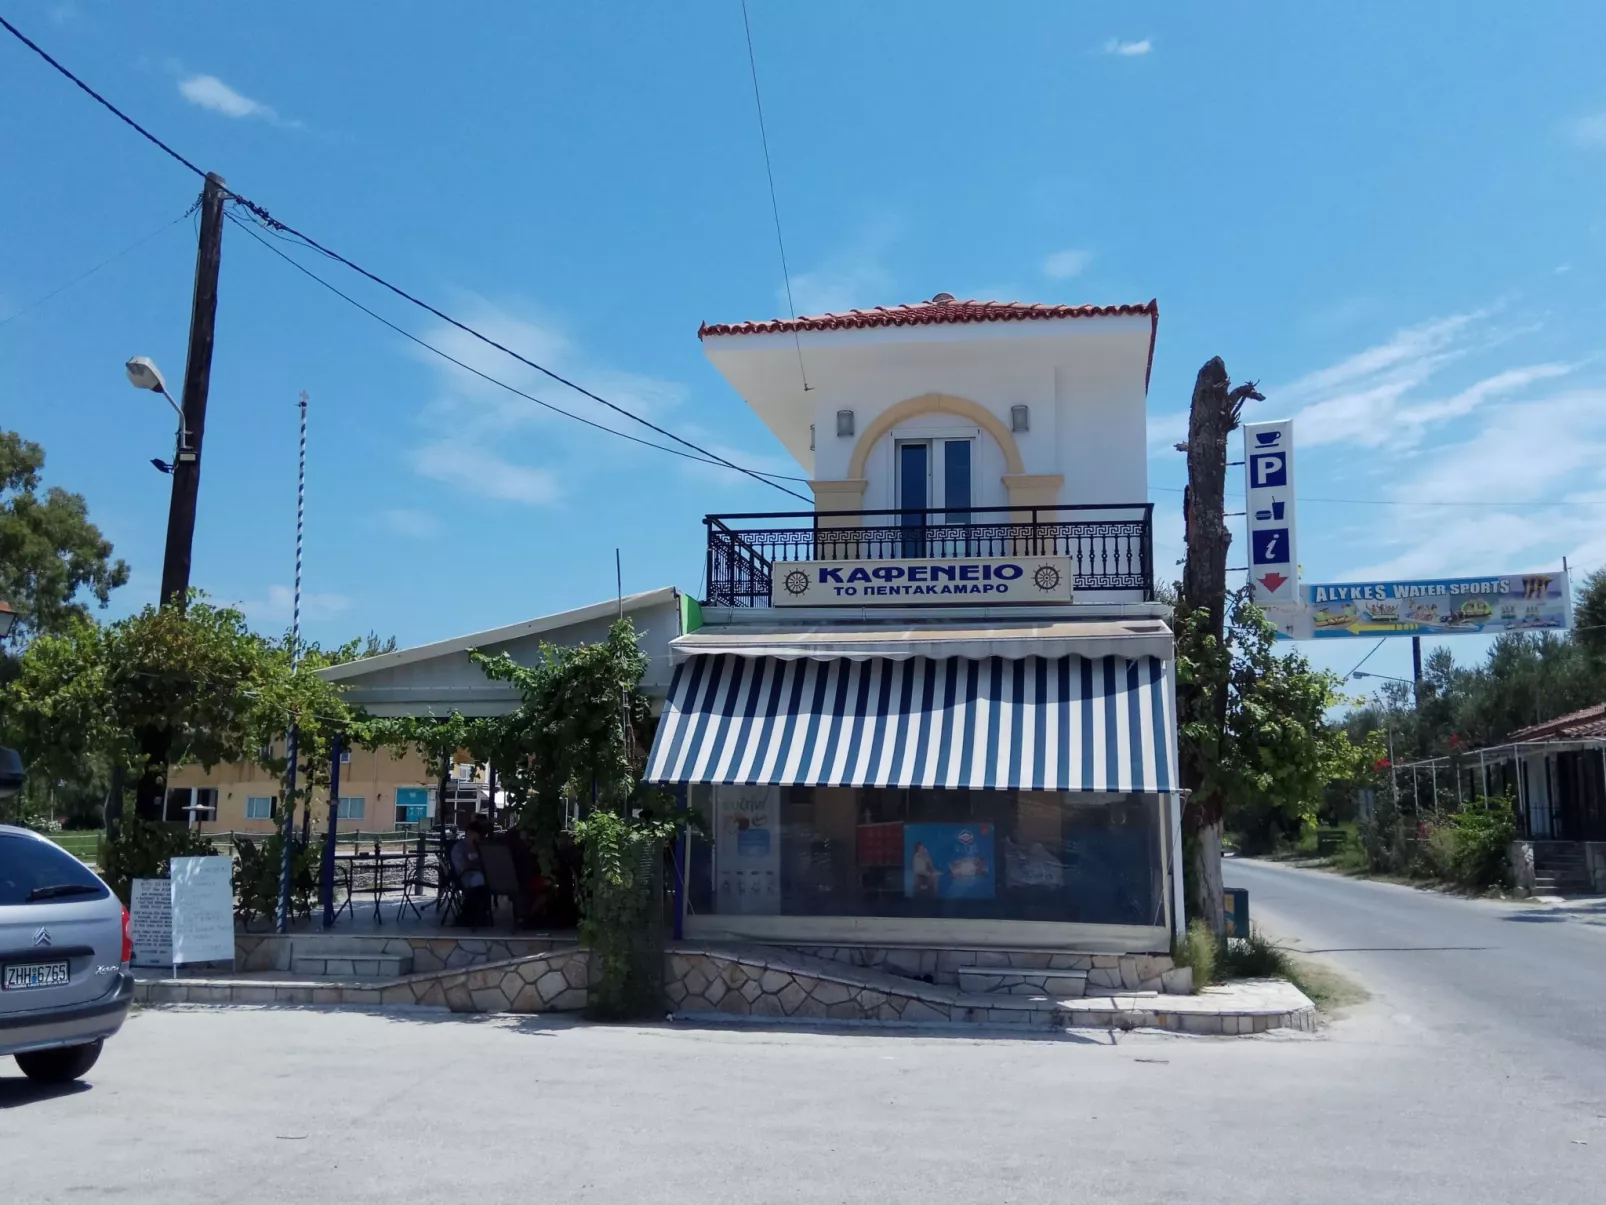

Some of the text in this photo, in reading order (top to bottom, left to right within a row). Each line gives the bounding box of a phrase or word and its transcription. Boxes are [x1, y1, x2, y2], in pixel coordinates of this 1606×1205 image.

[1258, 457, 1282, 484] P
[818, 564, 1023, 583] ΚΑΦΕΝΕΙΟ
[834, 583, 1008, 596] ΤΟ ΠΕΝΤΑΚΑΜΑΡΟ
[1315, 580, 1510, 602] ALYKES WATER SPORTS
[8, 965, 65, 984] ZHH 6765
